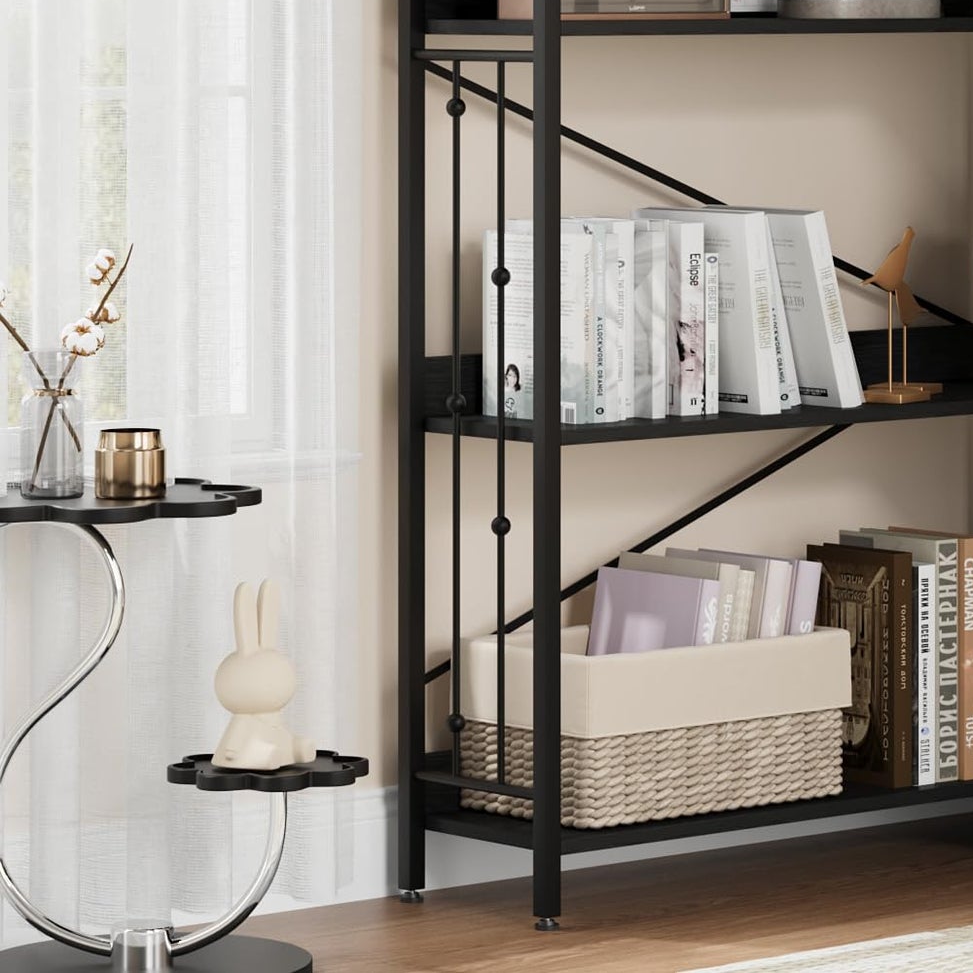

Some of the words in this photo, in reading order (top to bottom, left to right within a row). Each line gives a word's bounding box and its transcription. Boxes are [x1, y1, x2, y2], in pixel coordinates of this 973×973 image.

[687, 253, 701, 286] Eclipse
[708, 275, 716, 285] THE
[754, 268, 767, 283] THE
[818, 266, 832, 281] THE
[708, 286, 716, 302] GREAT
[920, 577, 930, 608] ПРЯТКИ
[920, 610, 930, 621] НА
[939, 551, 957, 686] ПАСТЕРНАК
[920, 624, 930, 654] ОСЕВОЙ
[939, 694, 957, 768] БОРИС
